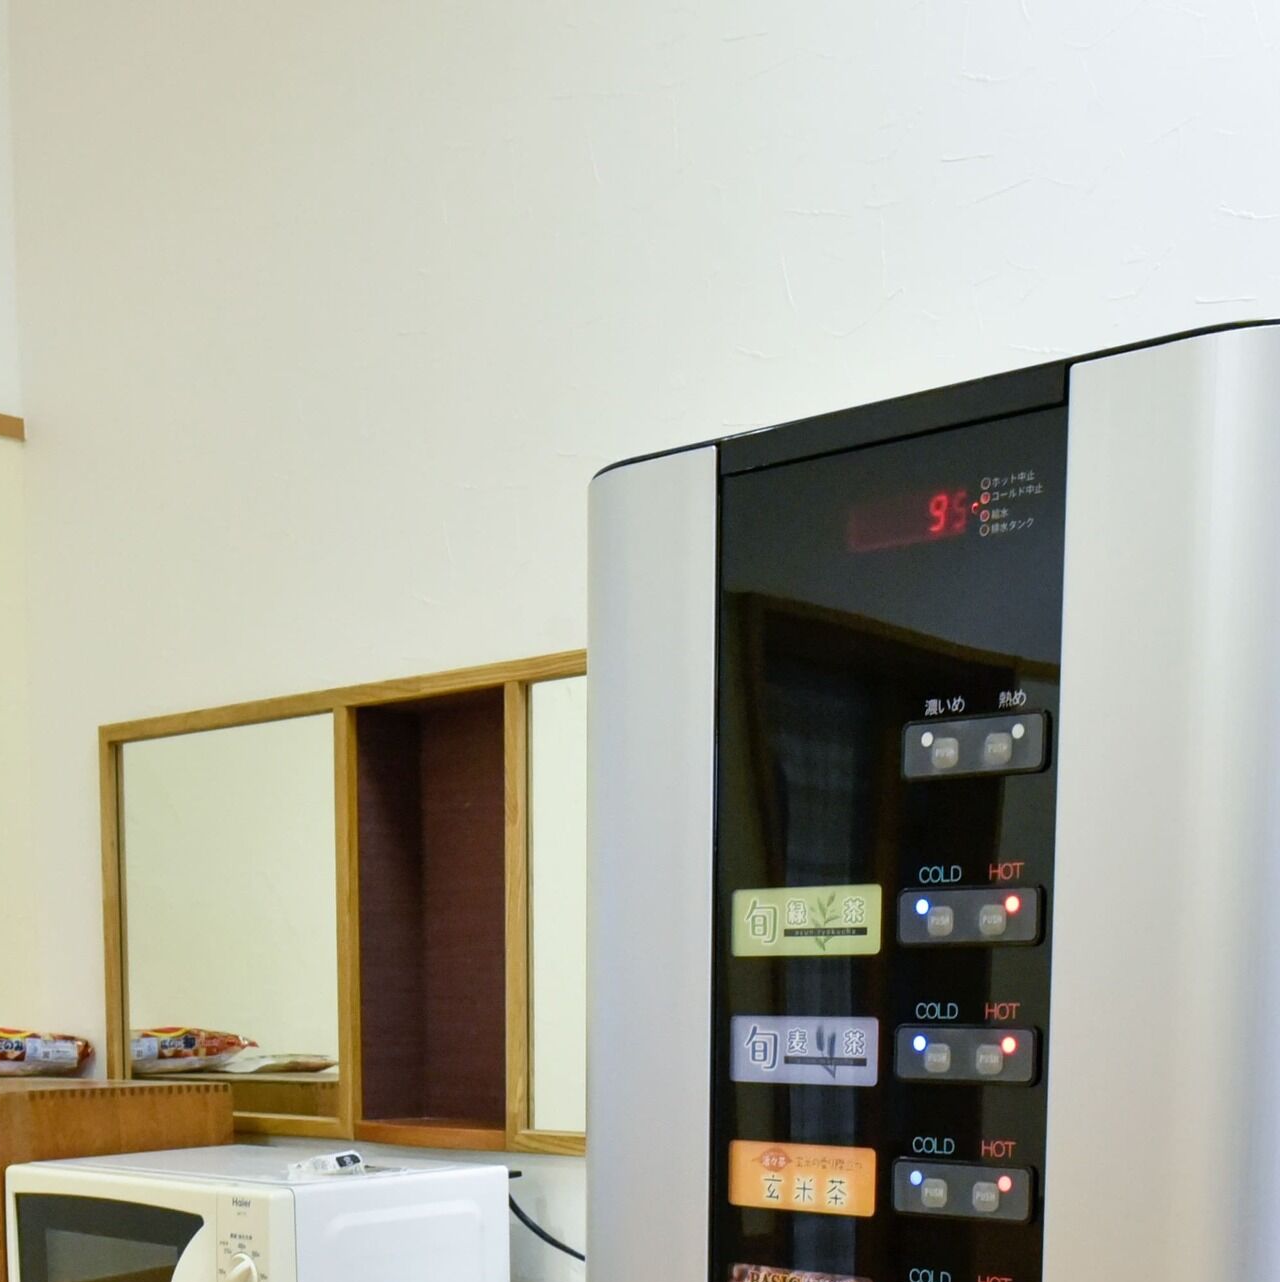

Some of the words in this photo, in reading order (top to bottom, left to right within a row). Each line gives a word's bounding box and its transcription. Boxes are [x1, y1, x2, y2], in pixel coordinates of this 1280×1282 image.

[924, 695, 966, 716] 濃いめ
[998, 688, 1027, 709] 熱め
[919, 866, 962, 884] COLD
[988, 862, 1024, 881] HOT
[982, 914, 1003, 925] PUSH
[915, 1003, 959, 1020] COLD
[984, 1003, 1020, 1020] HOT
[979, 1054, 999, 1066] PUSH
[912, 1136, 956, 1155] COLD
[981, 1141, 1017, 1159] HOT
[763, 1174, 847, 1206] 玄米茶
[924, 1186, 944, 1198] PUSH
[975, 1190, 996, 1202] PUSH
